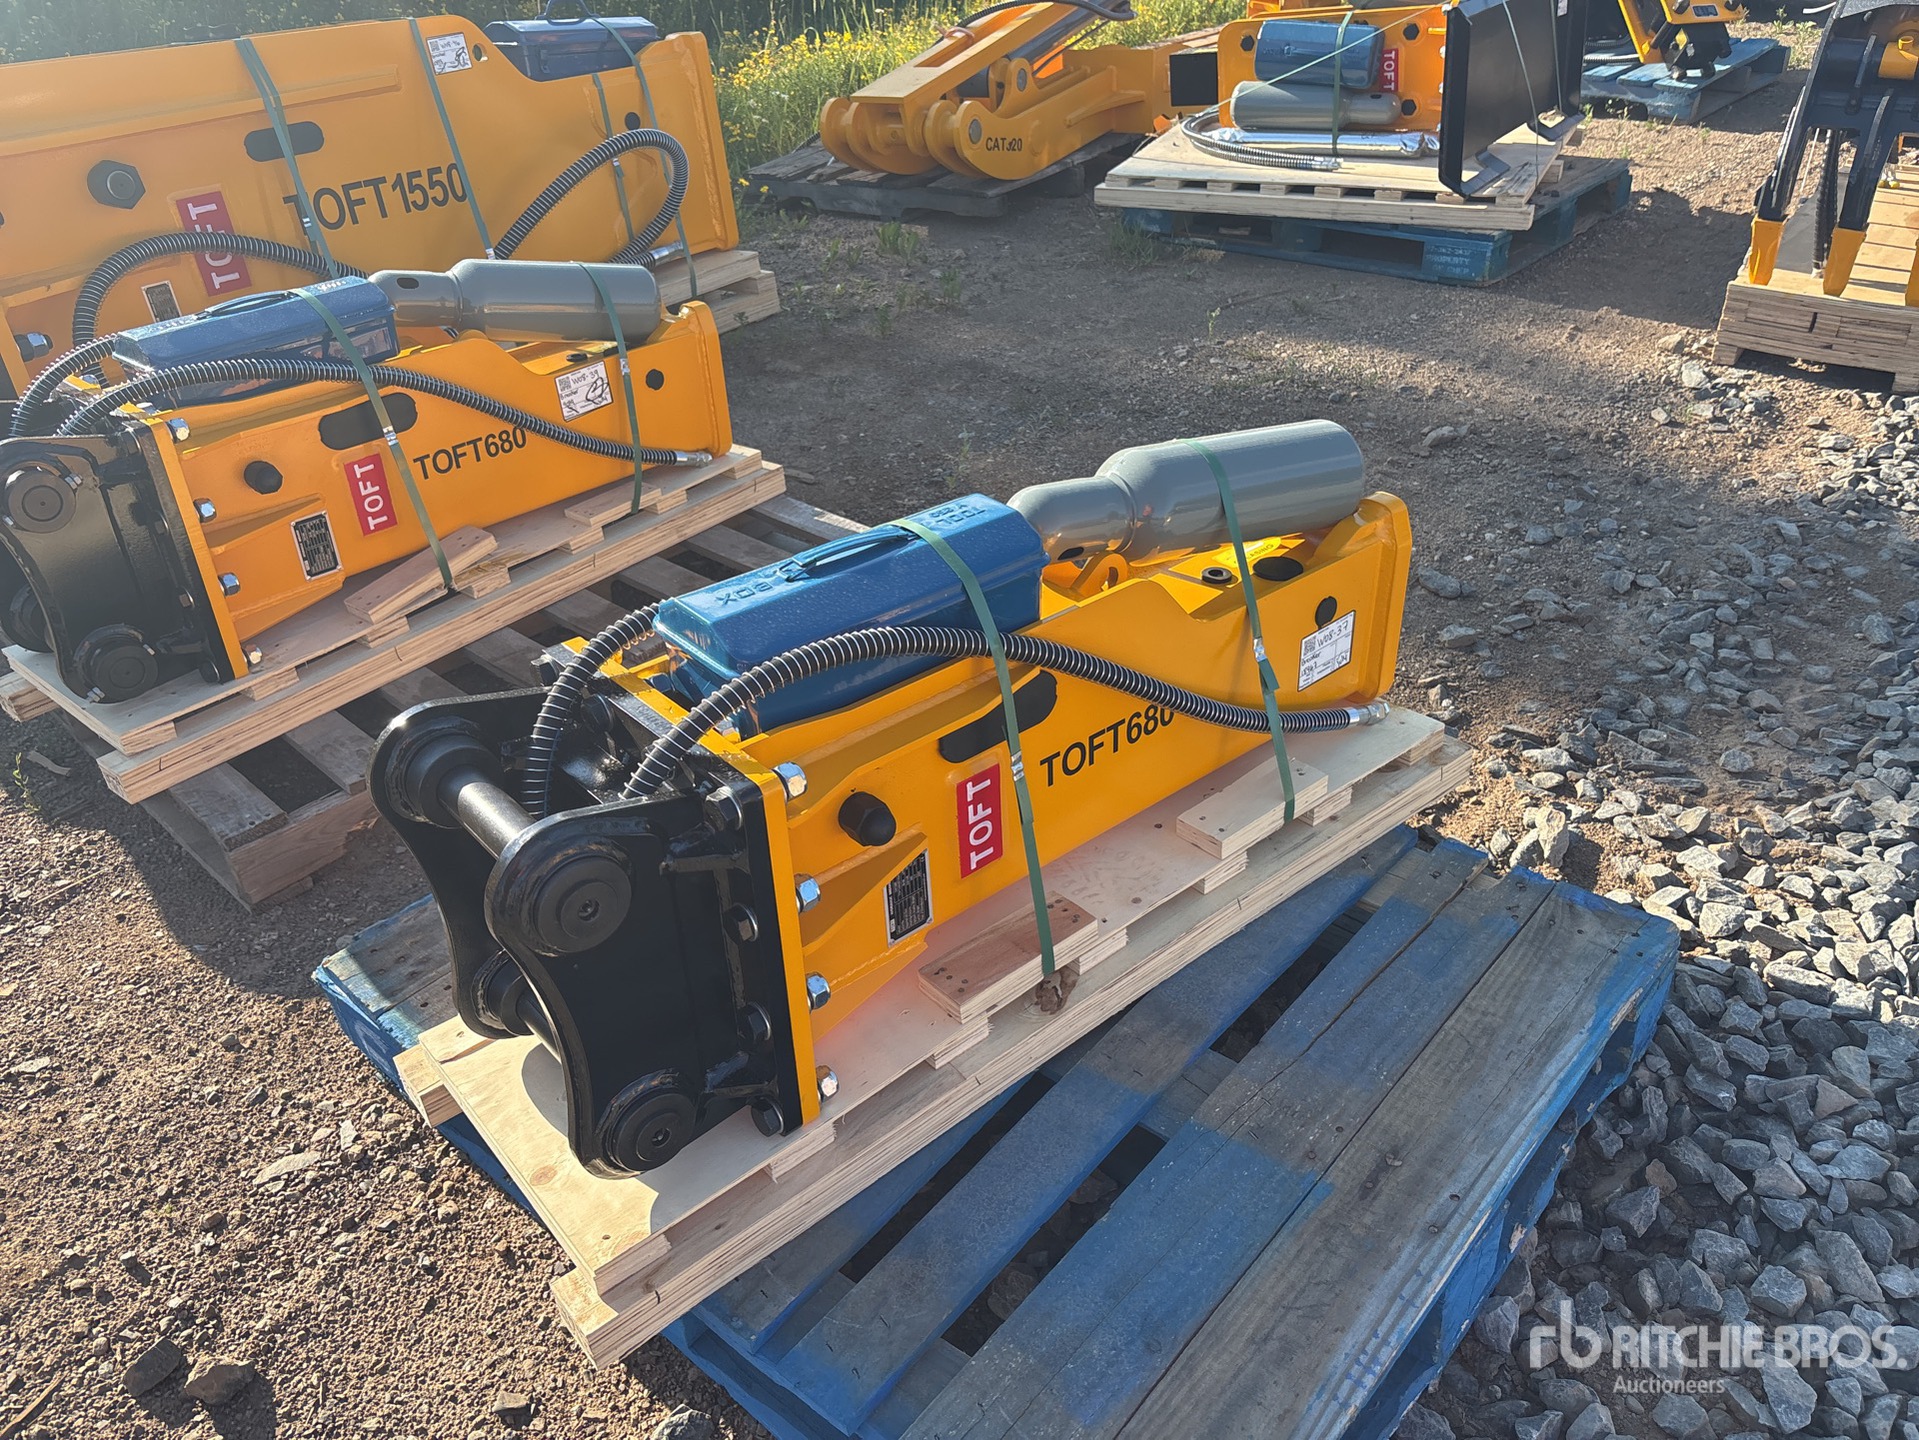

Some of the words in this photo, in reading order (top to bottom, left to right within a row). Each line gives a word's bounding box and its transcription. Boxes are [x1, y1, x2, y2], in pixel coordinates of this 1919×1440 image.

[1383, 51, 1396, 91] TOFT
[283, 162, 468, 236] TOFT1550
[413, 427, 527, 480] TOFT680
[353, 463, 389, 531] TOFT
[935, 507, 986, 525] TOOL
[716, 581, 773, 605] BOX
[1316, 619, 1349, 647] W08-37
[1039, 705, 1174, 787] TOFT680
[966, 778, 995, 871] TOFT
